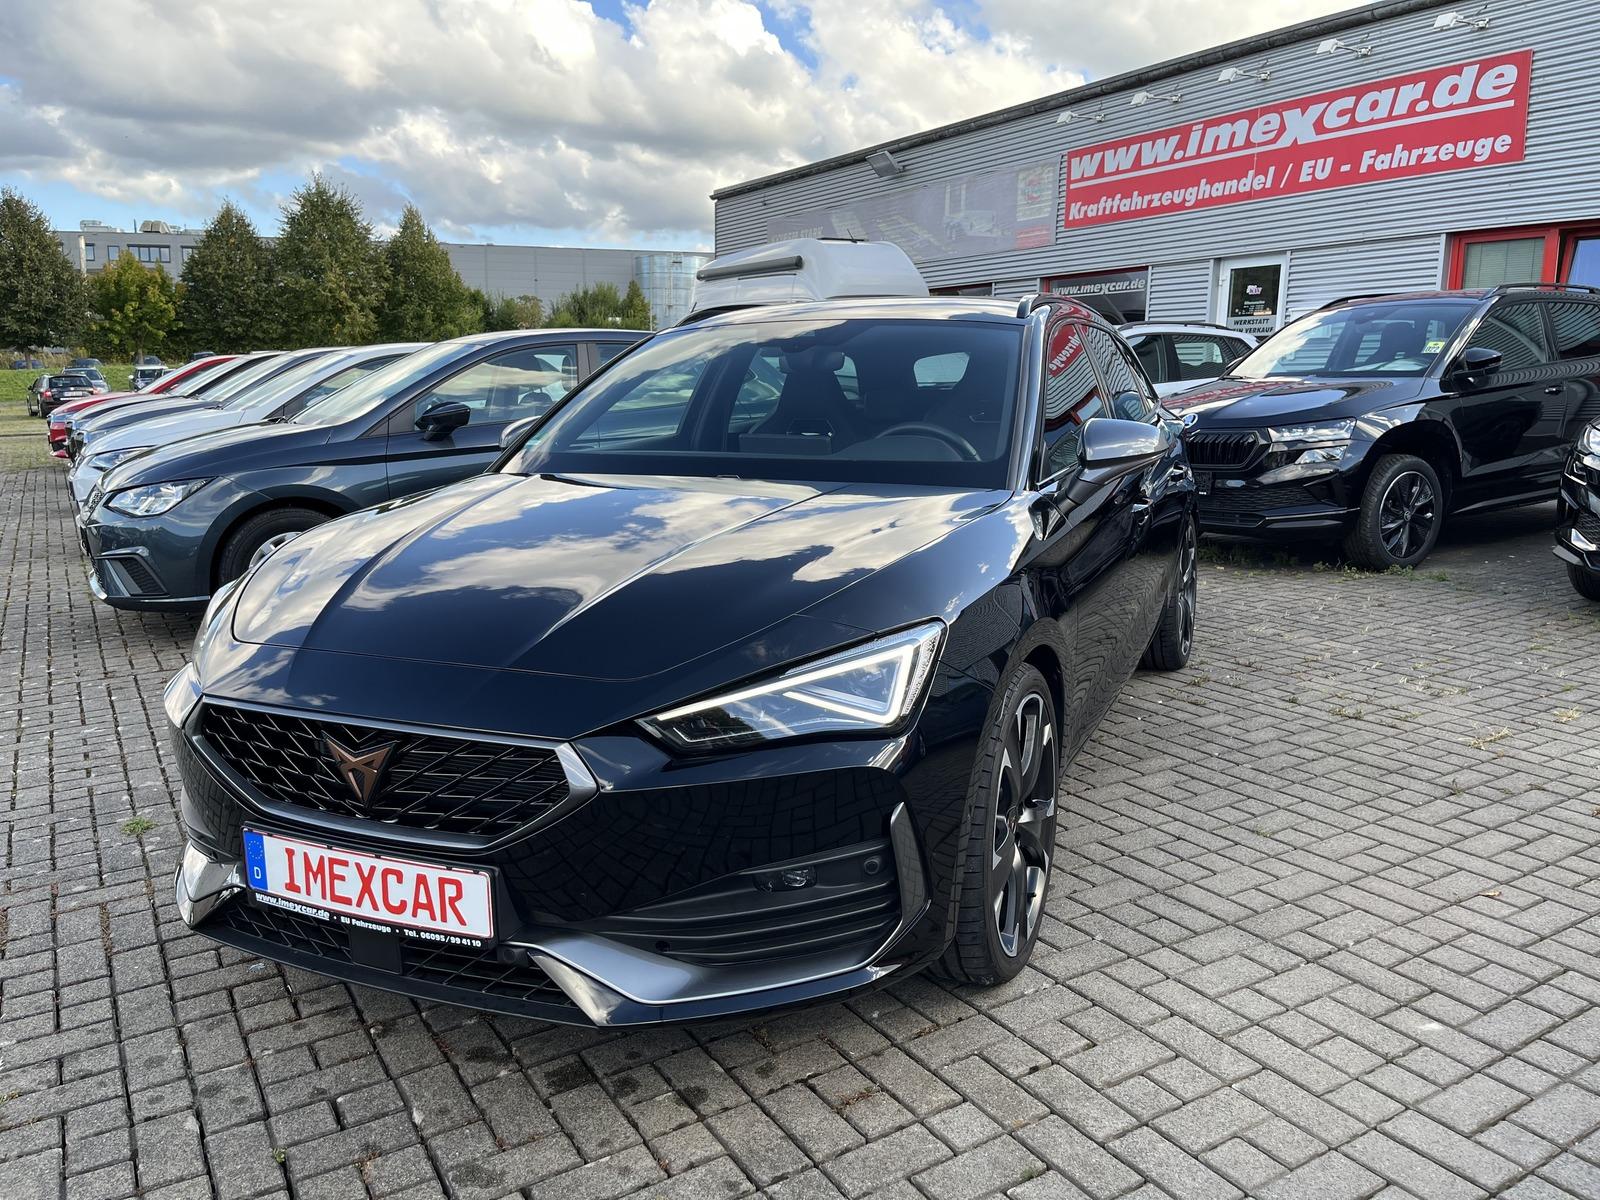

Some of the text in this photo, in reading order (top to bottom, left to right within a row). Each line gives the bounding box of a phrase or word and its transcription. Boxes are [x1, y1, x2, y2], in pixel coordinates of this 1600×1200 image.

[1070, 62, 1518, 181] www.imexcar.de
[1068, 165, 1275, 221] Kraftfahrzeughandel
[1299, 156, 1334, 183] EU
[1358, 131, 1512, 174] Fahrzeuge
[1052, 278, 1146, 296] www.imexcar.de
[1233, 318, 1270, 326] WERKSTATT
[254, 866, 261, 879] D
[284, 847, 467, 926] IMEXCAR
[255, 892, 330, 921] www.imexcar.de
[340, 916, 351, 925] EU
[352, 919, 391, 933] Fahrzeuge
[403, 929, 419, 938] Tel.
